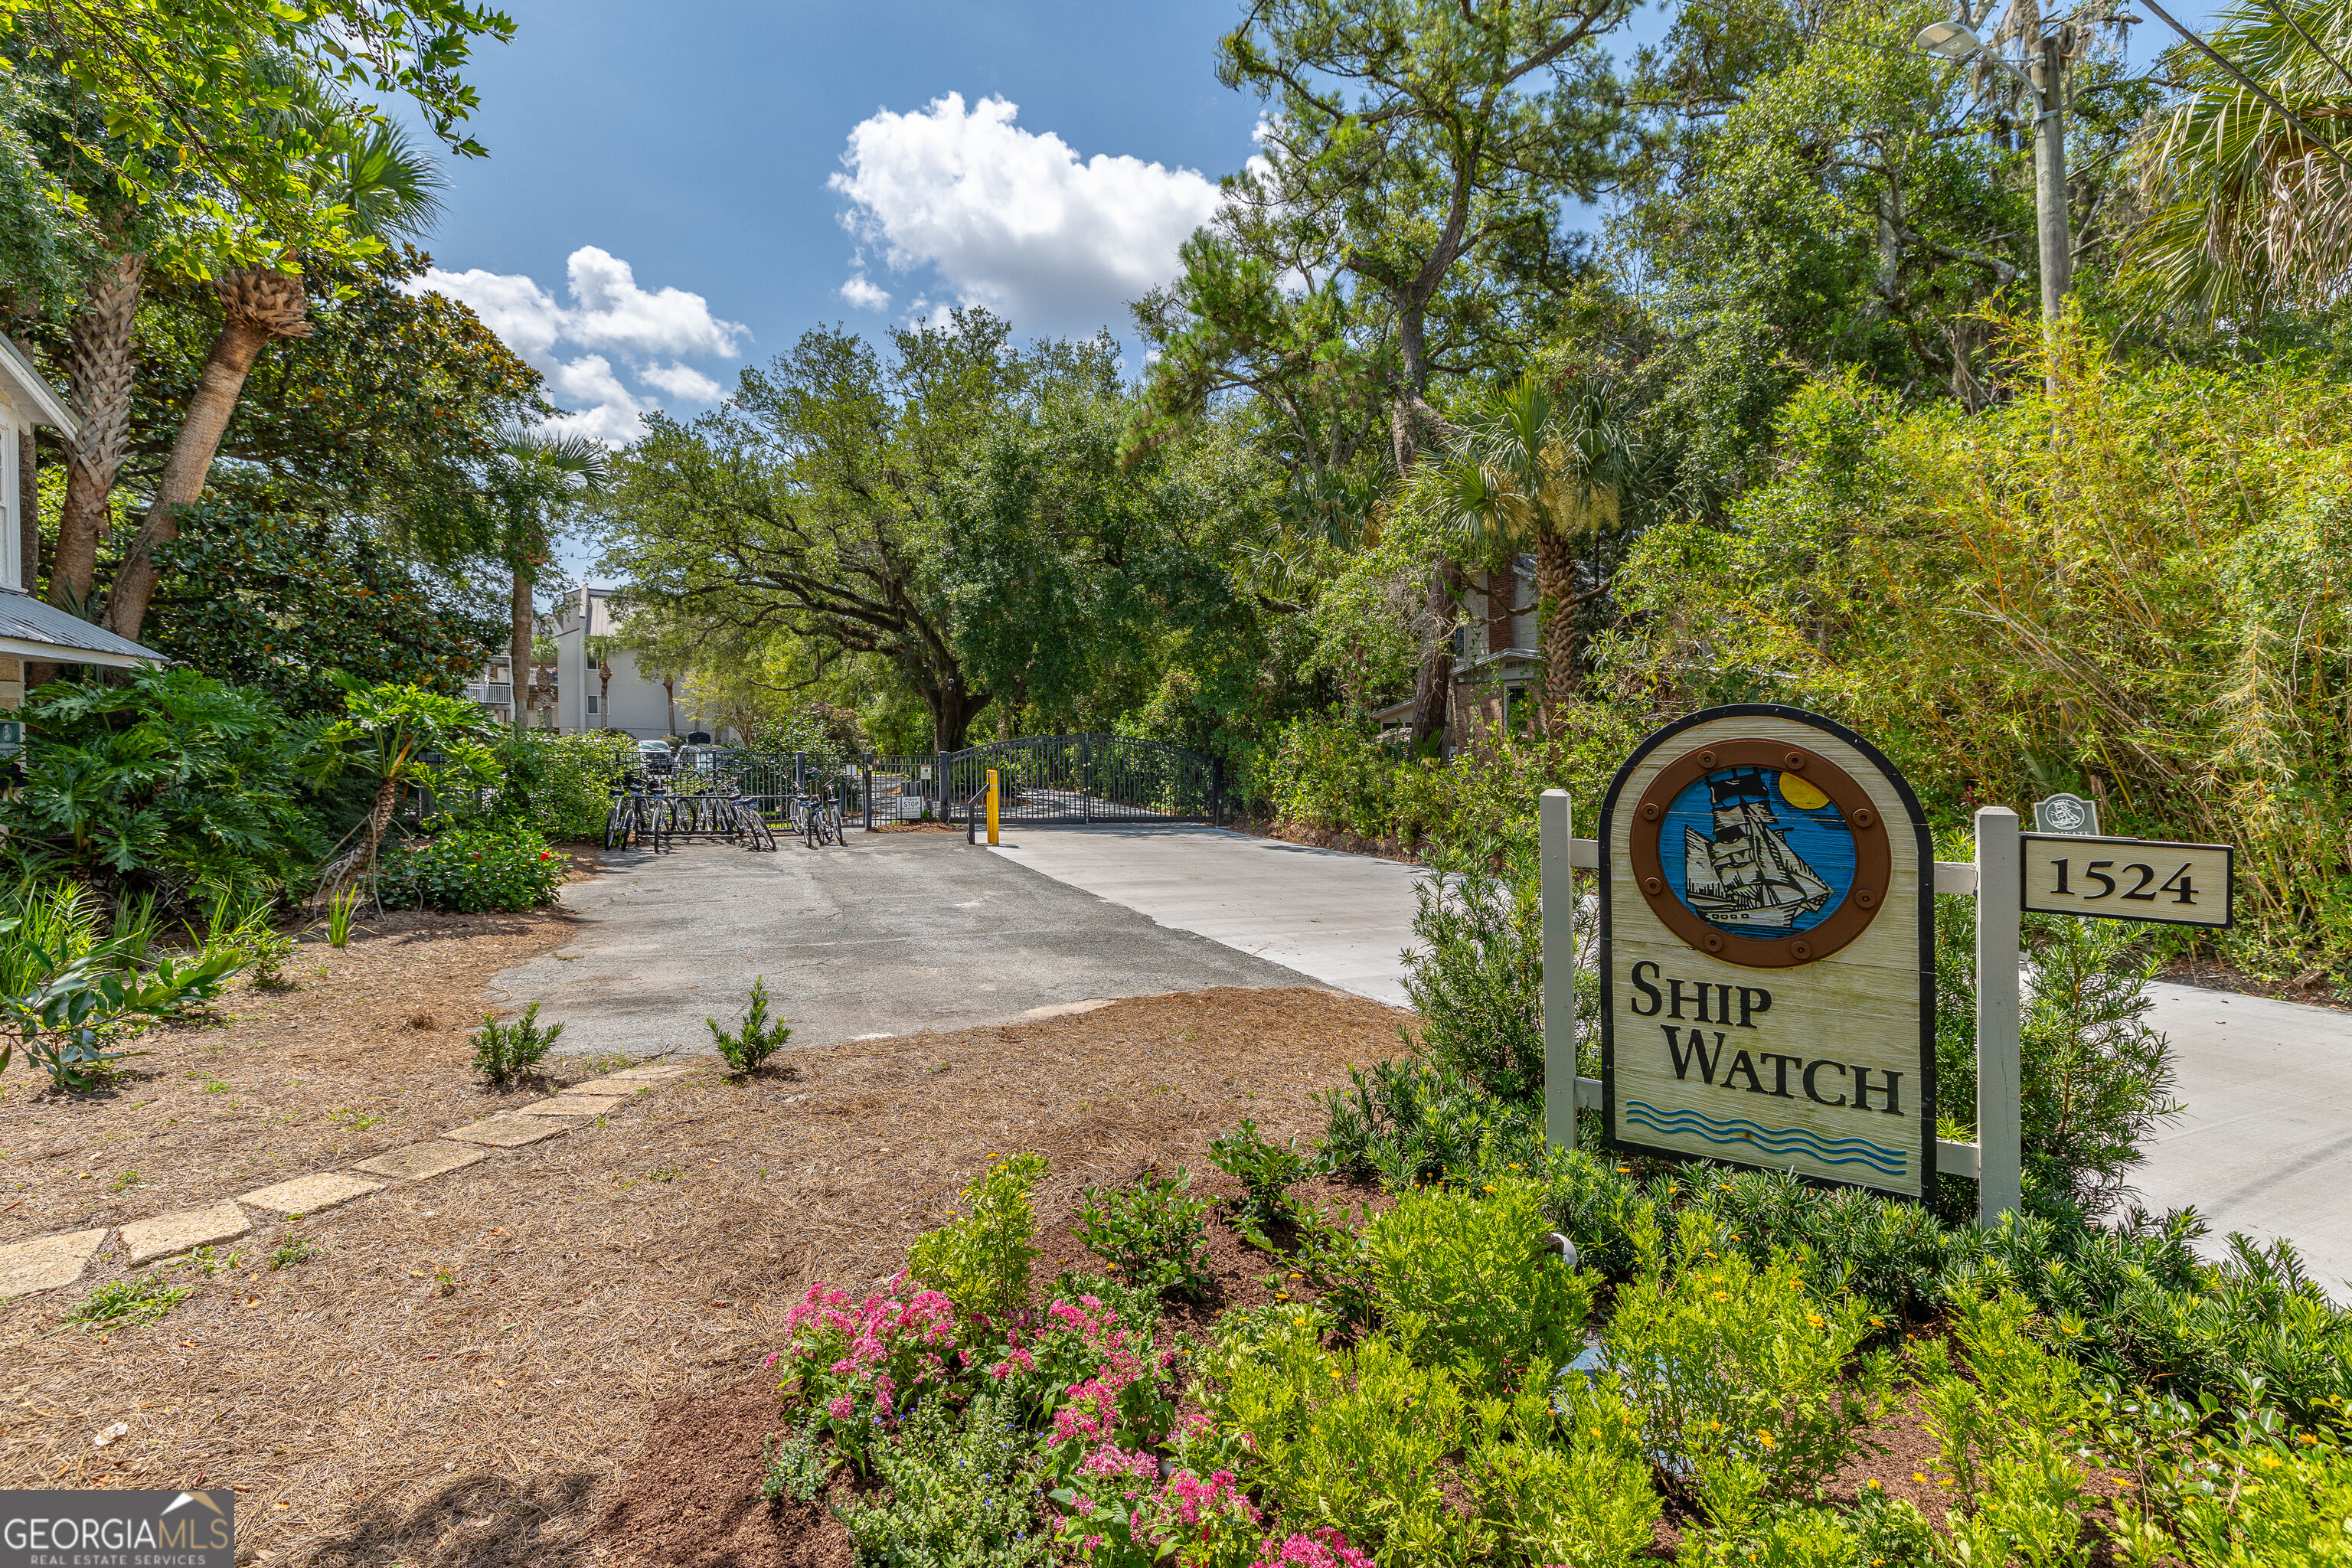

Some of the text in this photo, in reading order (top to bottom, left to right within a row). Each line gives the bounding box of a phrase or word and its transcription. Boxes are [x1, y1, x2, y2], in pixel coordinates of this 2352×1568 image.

[2050, 858, 2199, 905] 1524
[1631, 960, 1772, 1029] SHIP
[1660, 1024, 1905, 1116] WATCH
